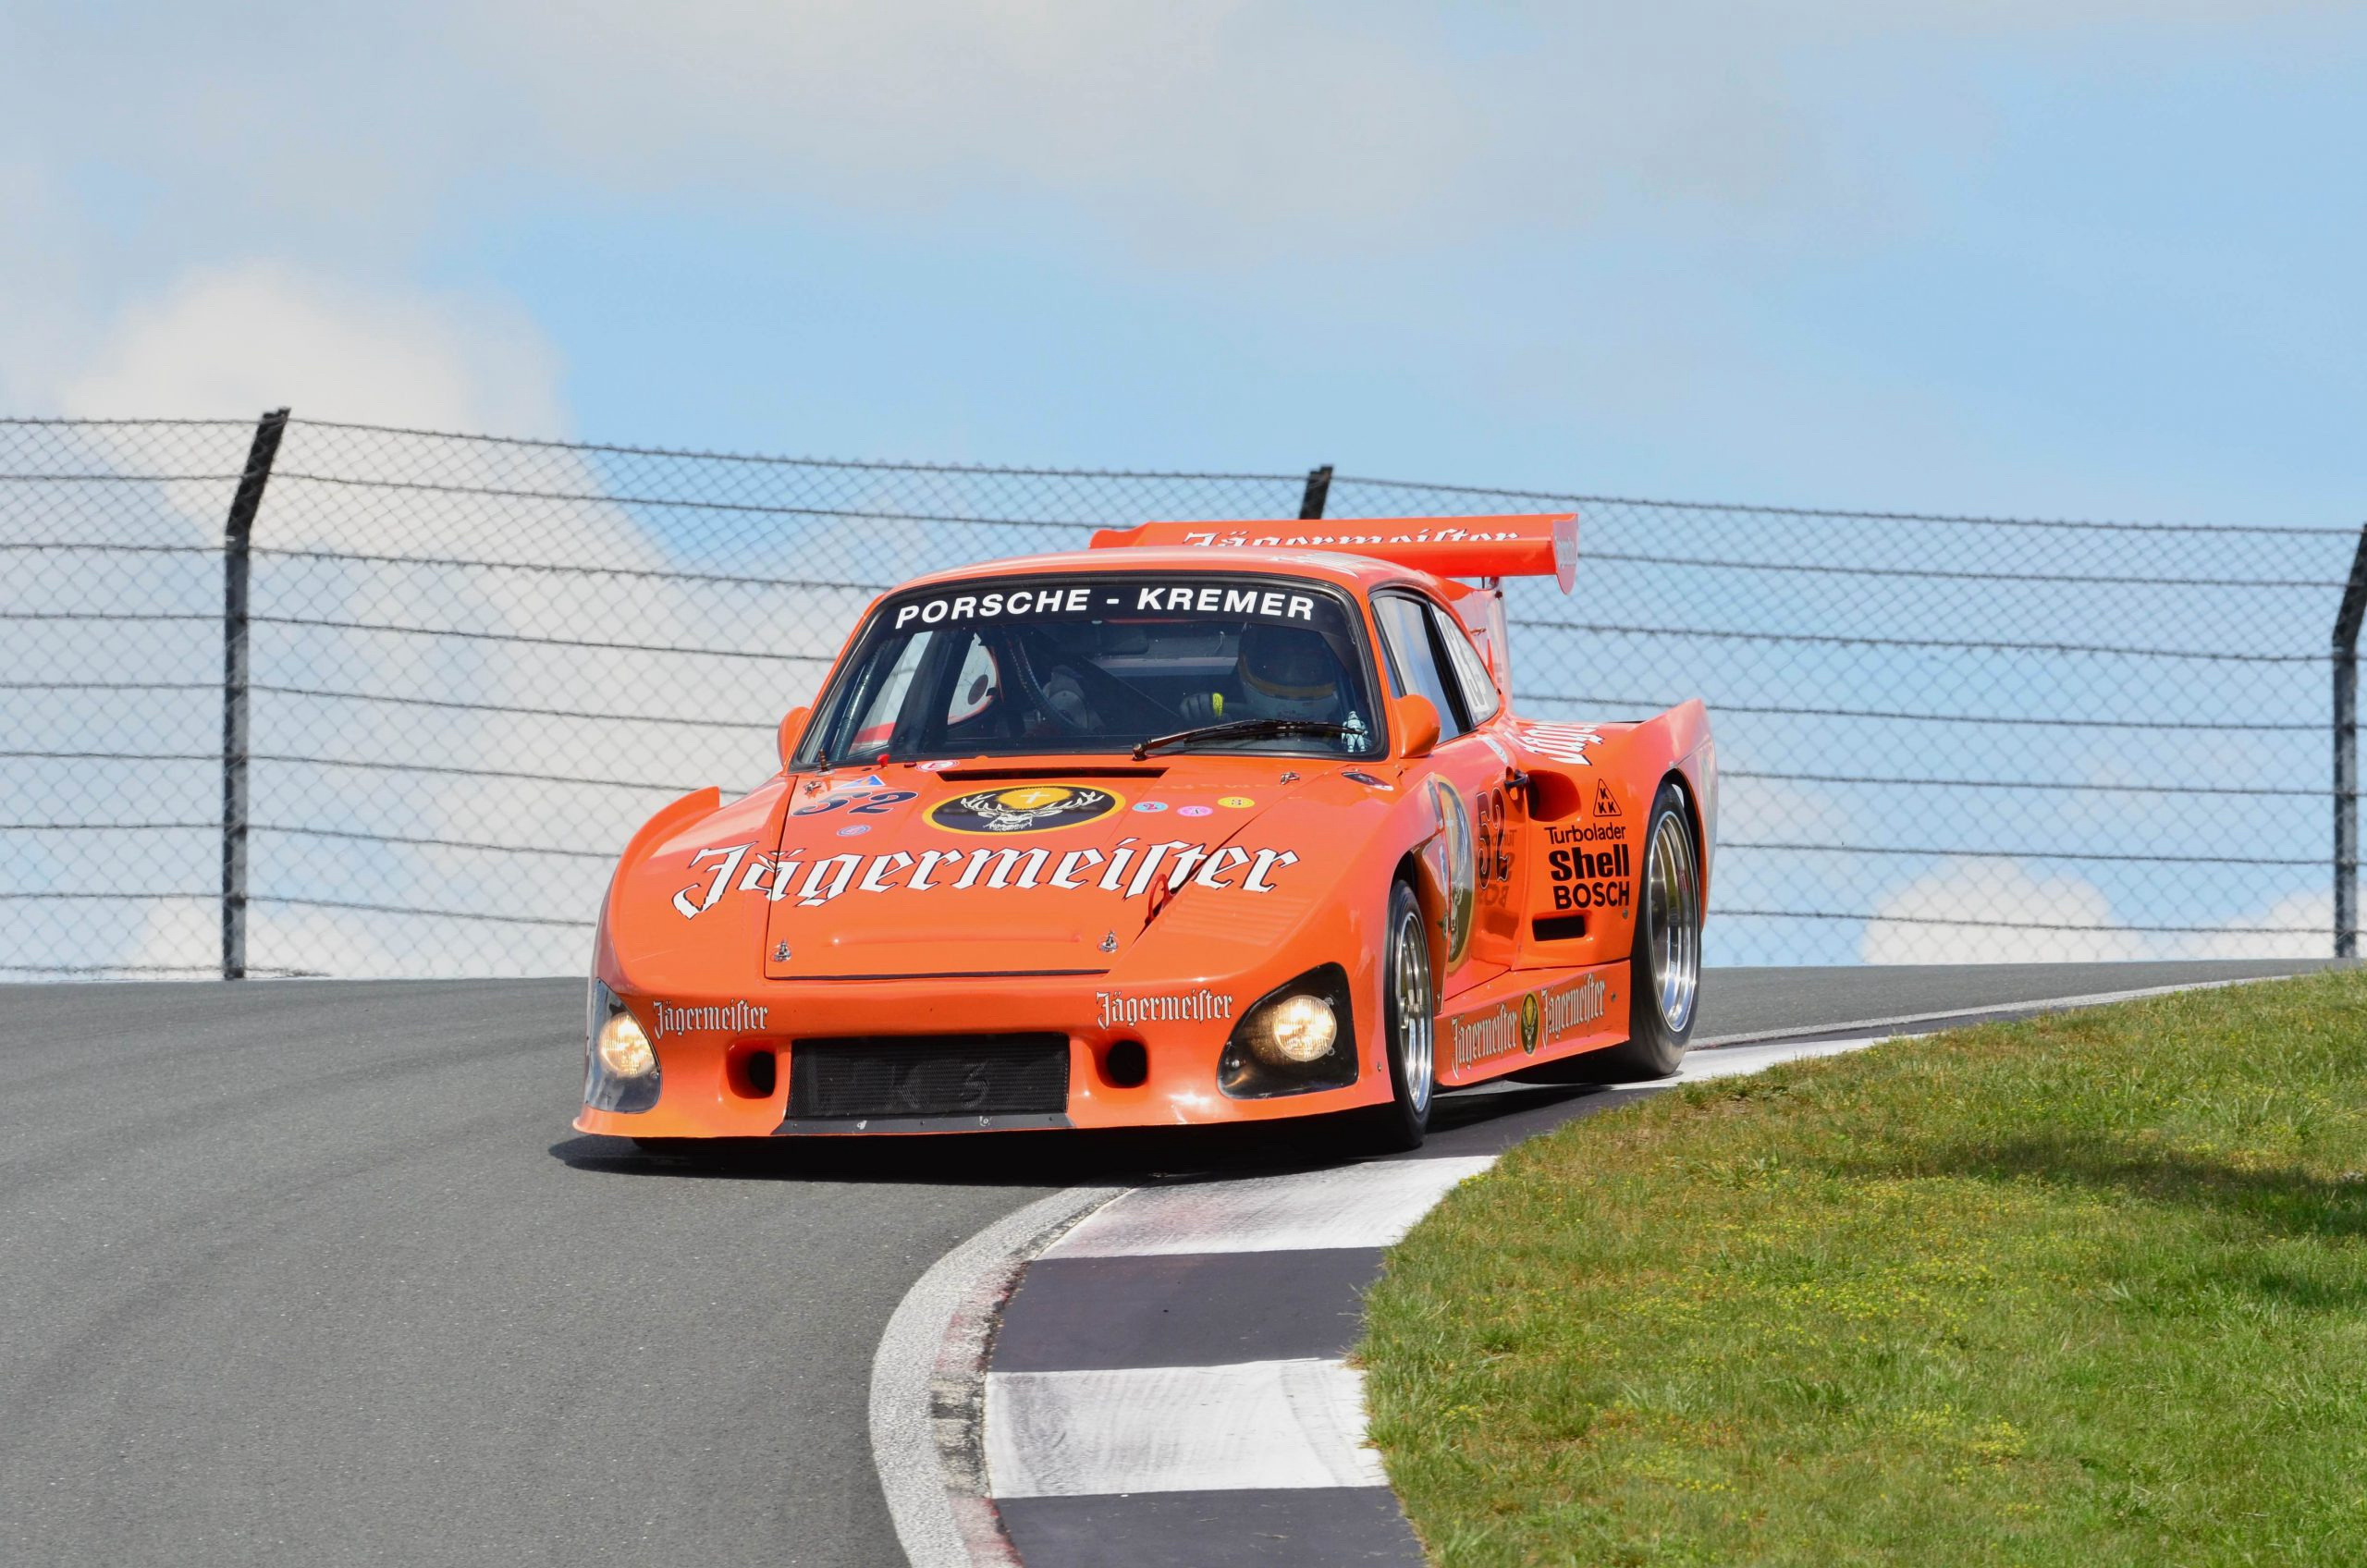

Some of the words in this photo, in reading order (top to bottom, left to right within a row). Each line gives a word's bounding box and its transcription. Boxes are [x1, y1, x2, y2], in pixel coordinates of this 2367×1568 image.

[894, 589, 1090, 631] PORSCHE
[1137, 586, 1315, 621] KREMER
[791, 791, 919, 816] 52
[1476, 787, 1509, 889] 52
[1544, 821, 1626, 844] Turbolader
[1549, 843, 1630, 882] Shell
[1553, 880, 1630, 911] BOSCH
